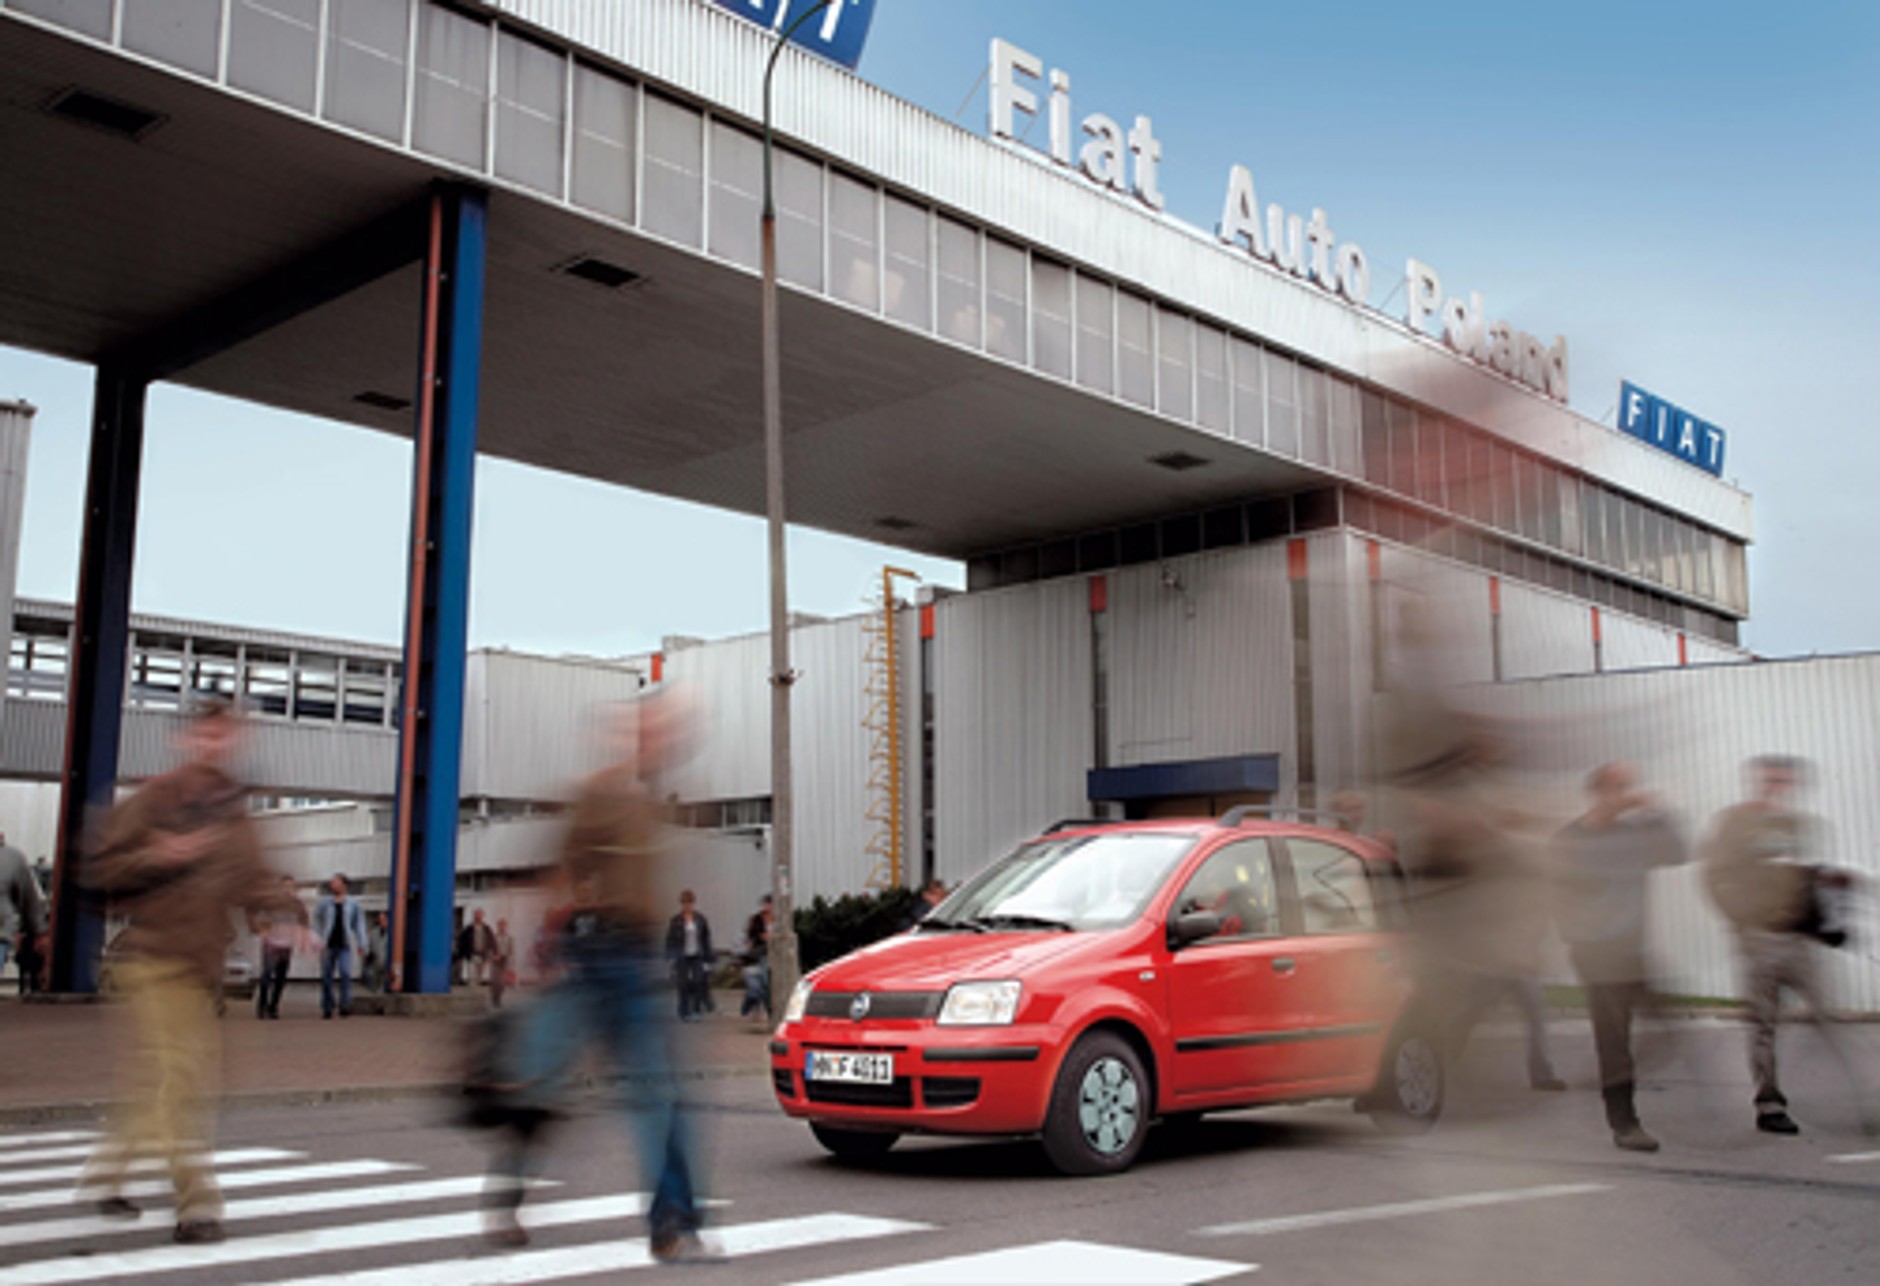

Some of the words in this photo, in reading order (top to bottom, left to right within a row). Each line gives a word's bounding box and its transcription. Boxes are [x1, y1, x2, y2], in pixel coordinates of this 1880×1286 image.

[989, 37, 1164, 211] Fiat
[1217, 163, 1371, 302] Auto
[1405, 257, 1569, 405] Poland
[1627, 390, 1722, 466] FIAT
